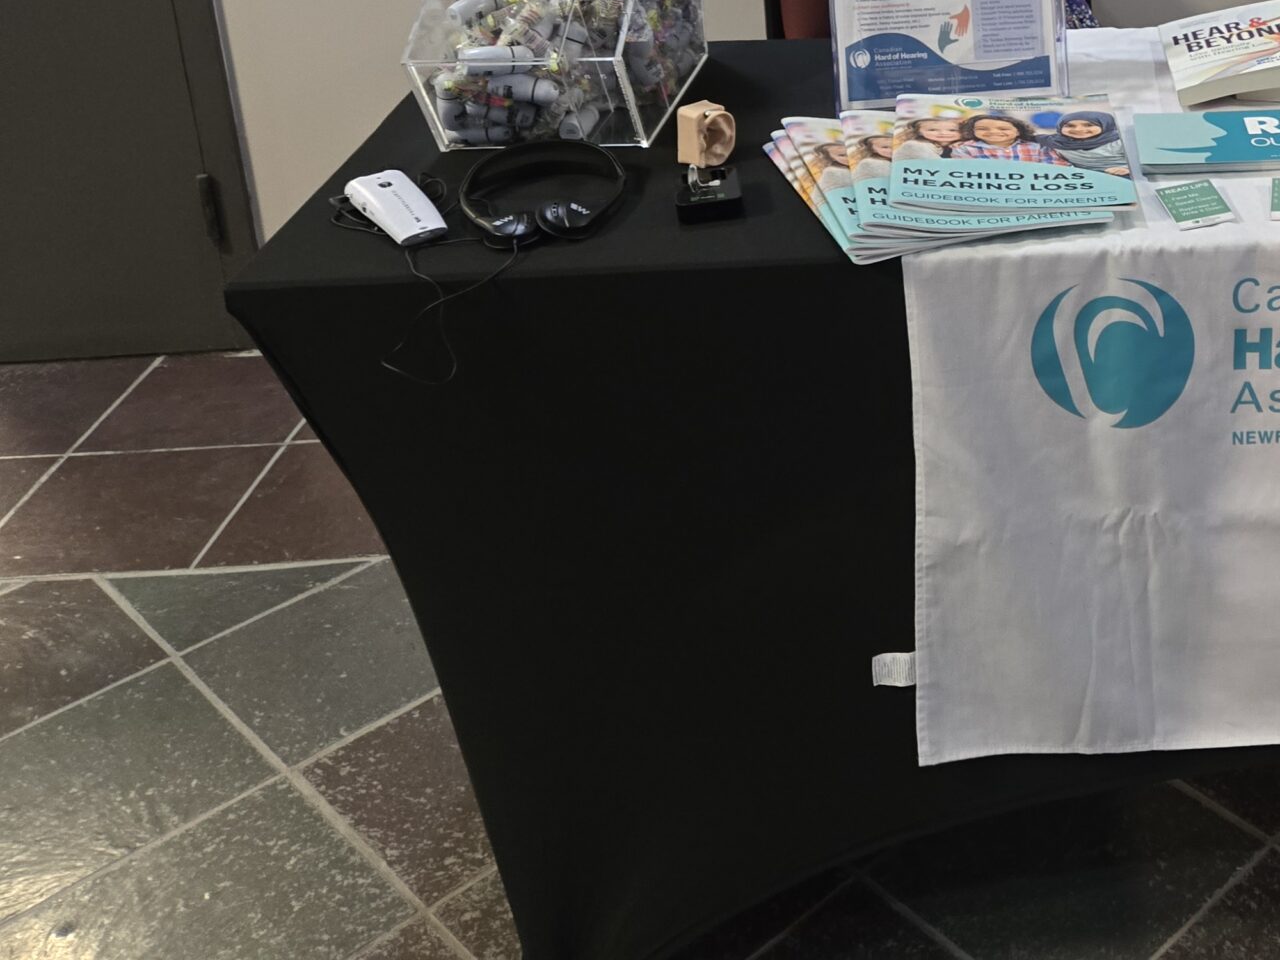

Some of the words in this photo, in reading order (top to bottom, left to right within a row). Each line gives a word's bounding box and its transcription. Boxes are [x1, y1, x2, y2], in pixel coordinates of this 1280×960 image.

[1172, 21, 1242, 46] HEAR
[1248, 17, 1268, 28] &
[875, 53, 890, 61] Hard
[900, 51, 928, 60] Hearing
[903, 166, 940, 176] MY
[949, 170, 1025, 181] CHILD
[1033, 171, 1086, 180] HAS
[902, 176, 1021, 191] HEARING
[1029, 182, 1094, 191] LOSS
[1164, 185, 1189, 194] READ
[1189, 182, 1209, 190] LIPS
[901, 191, 999, 204] GUIDEBOOK
[1004, 197, 1039, 205] FOR
[1042, 194, 1118, 205] PARENTS
[872, 211, 976, 226] GUIDEBOOK
[976, 215, 1011, 226] FOR
[1016, 210, 1092, 223] PARENTS
